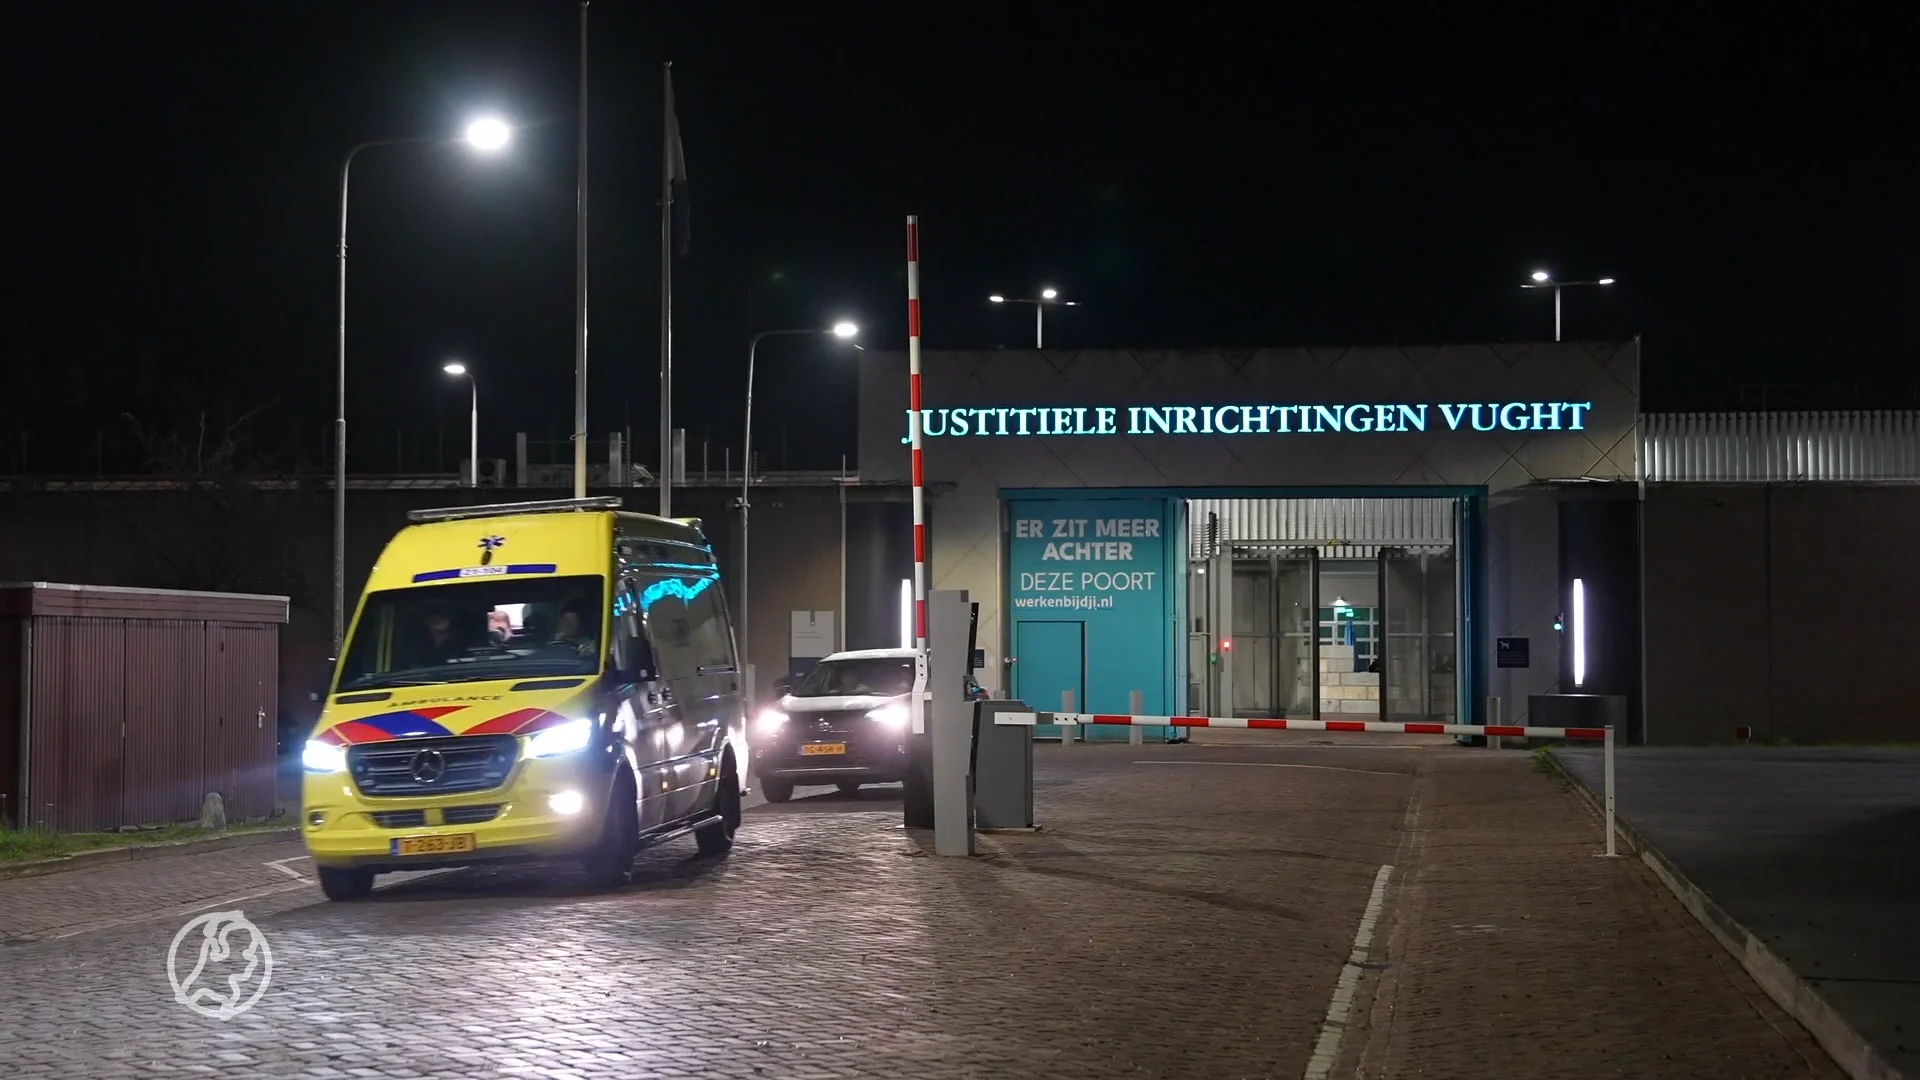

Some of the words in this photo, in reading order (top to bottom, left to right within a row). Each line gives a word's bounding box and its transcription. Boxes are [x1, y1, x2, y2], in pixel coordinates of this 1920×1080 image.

[901, 407, 1117, 443] JUSTITIELE
[1127, 404, 1428, 434] INRICHTINGEN
[1438, 401, 1591, 432] VUGHT
[1016, 519, 1044, 538] ER
[1051, 519, 1088, 538] ZIT
[1096, 518, 1160, 538] MEER
[1042, 541, 1133, 561] ACHTER
[1021, 572, 1074, 591] DEZE
[1082, 572, 1156, 591] POORT
[1015, 596, 1113, 610] werkenbijdji.nl
[387, 695, 504, 709] AMBULANCE
